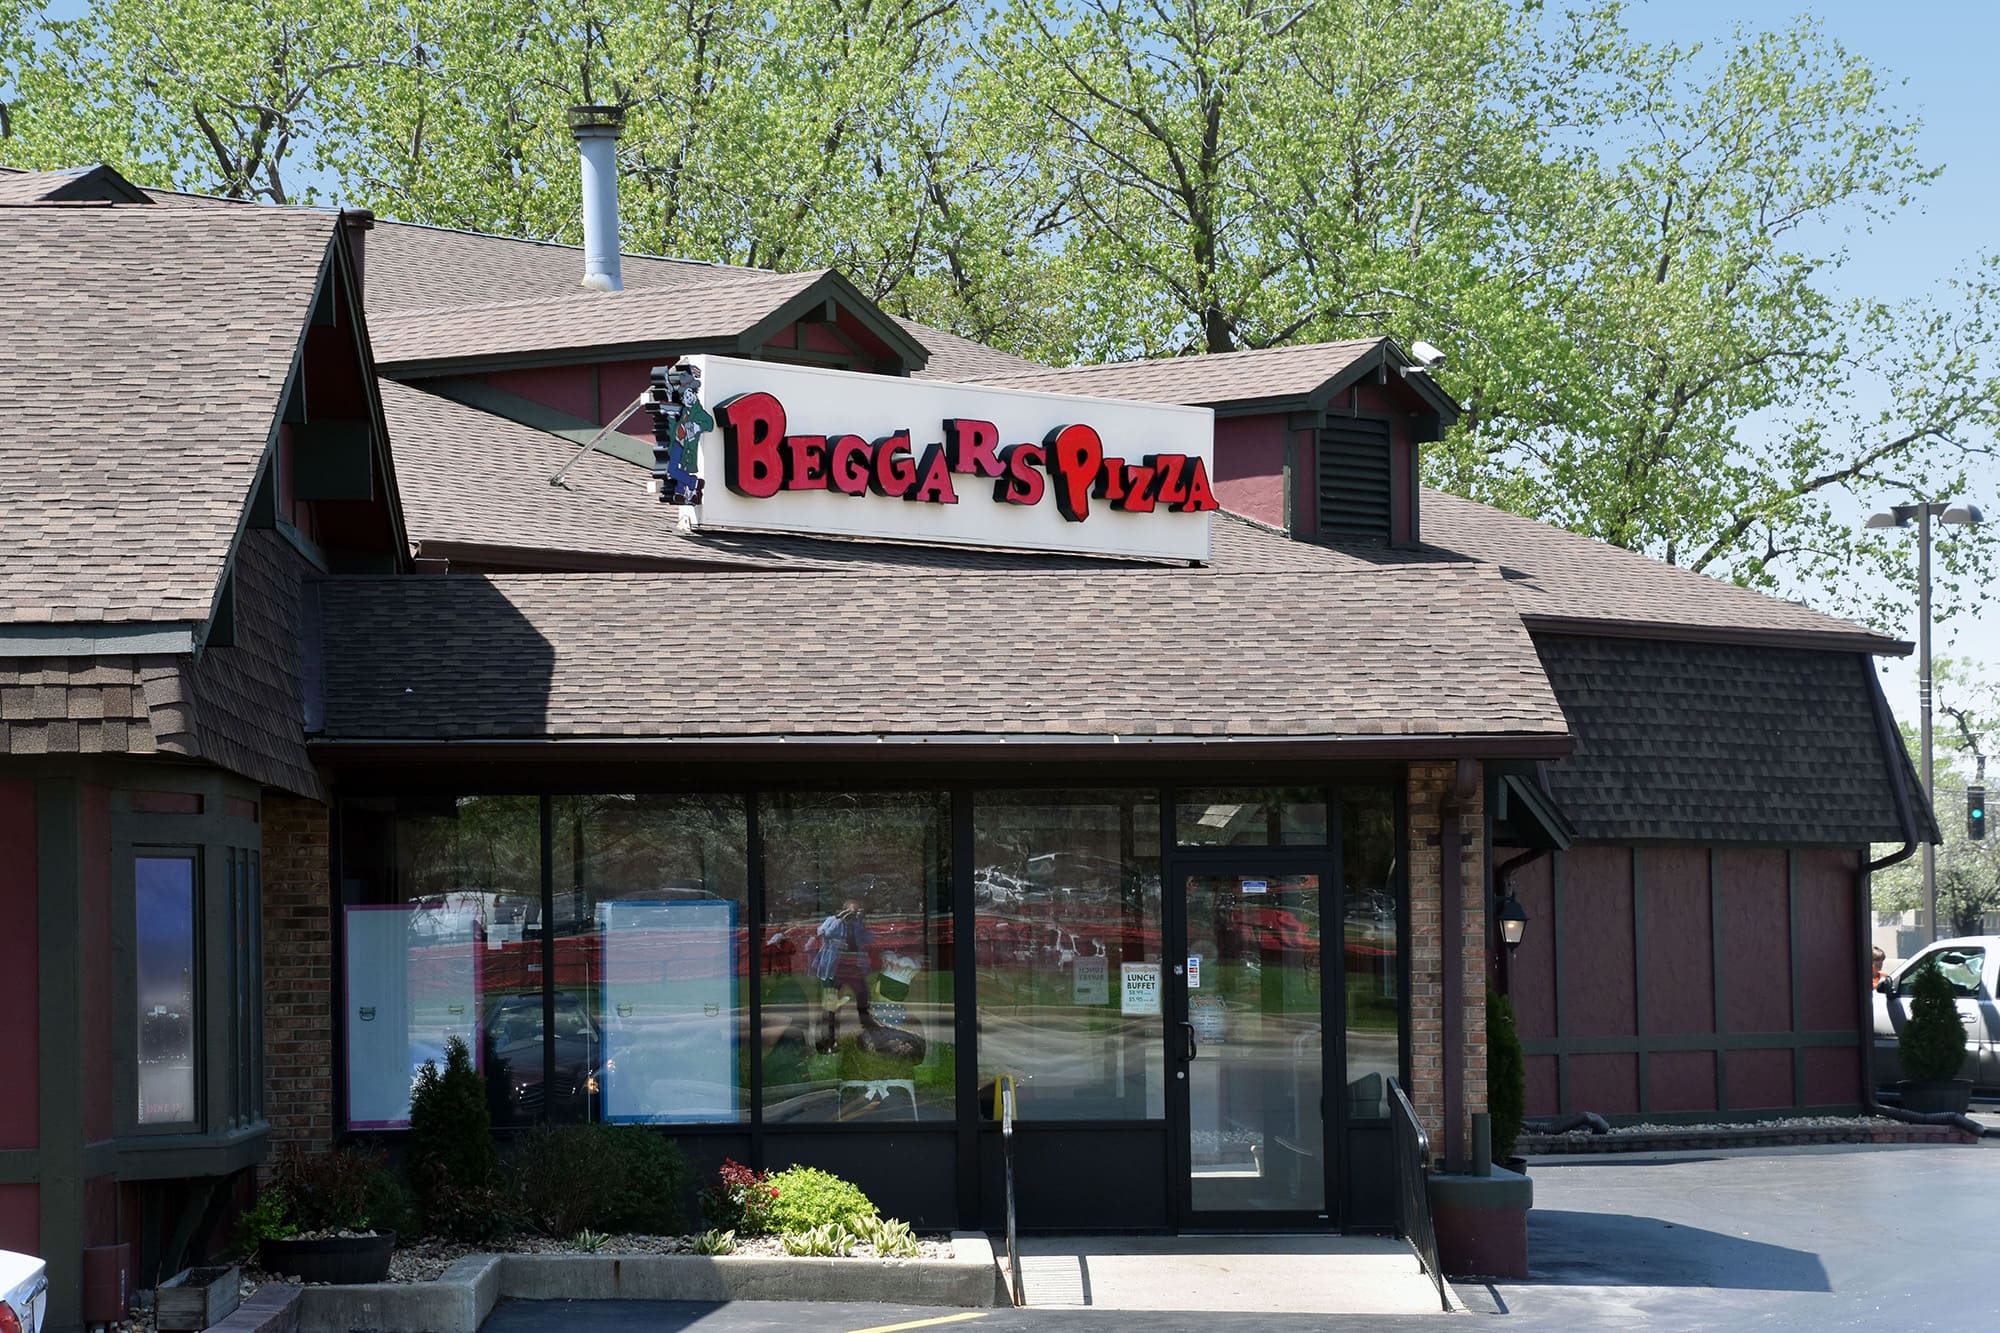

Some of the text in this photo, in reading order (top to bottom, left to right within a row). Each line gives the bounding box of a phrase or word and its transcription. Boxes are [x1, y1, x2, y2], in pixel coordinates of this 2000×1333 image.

[715, 391, 1220, 522] BEGGARS PIZZA
[1127, 974, 1155, 982] LUNCH
[1127, 982, 1155, 990] BUFFET
